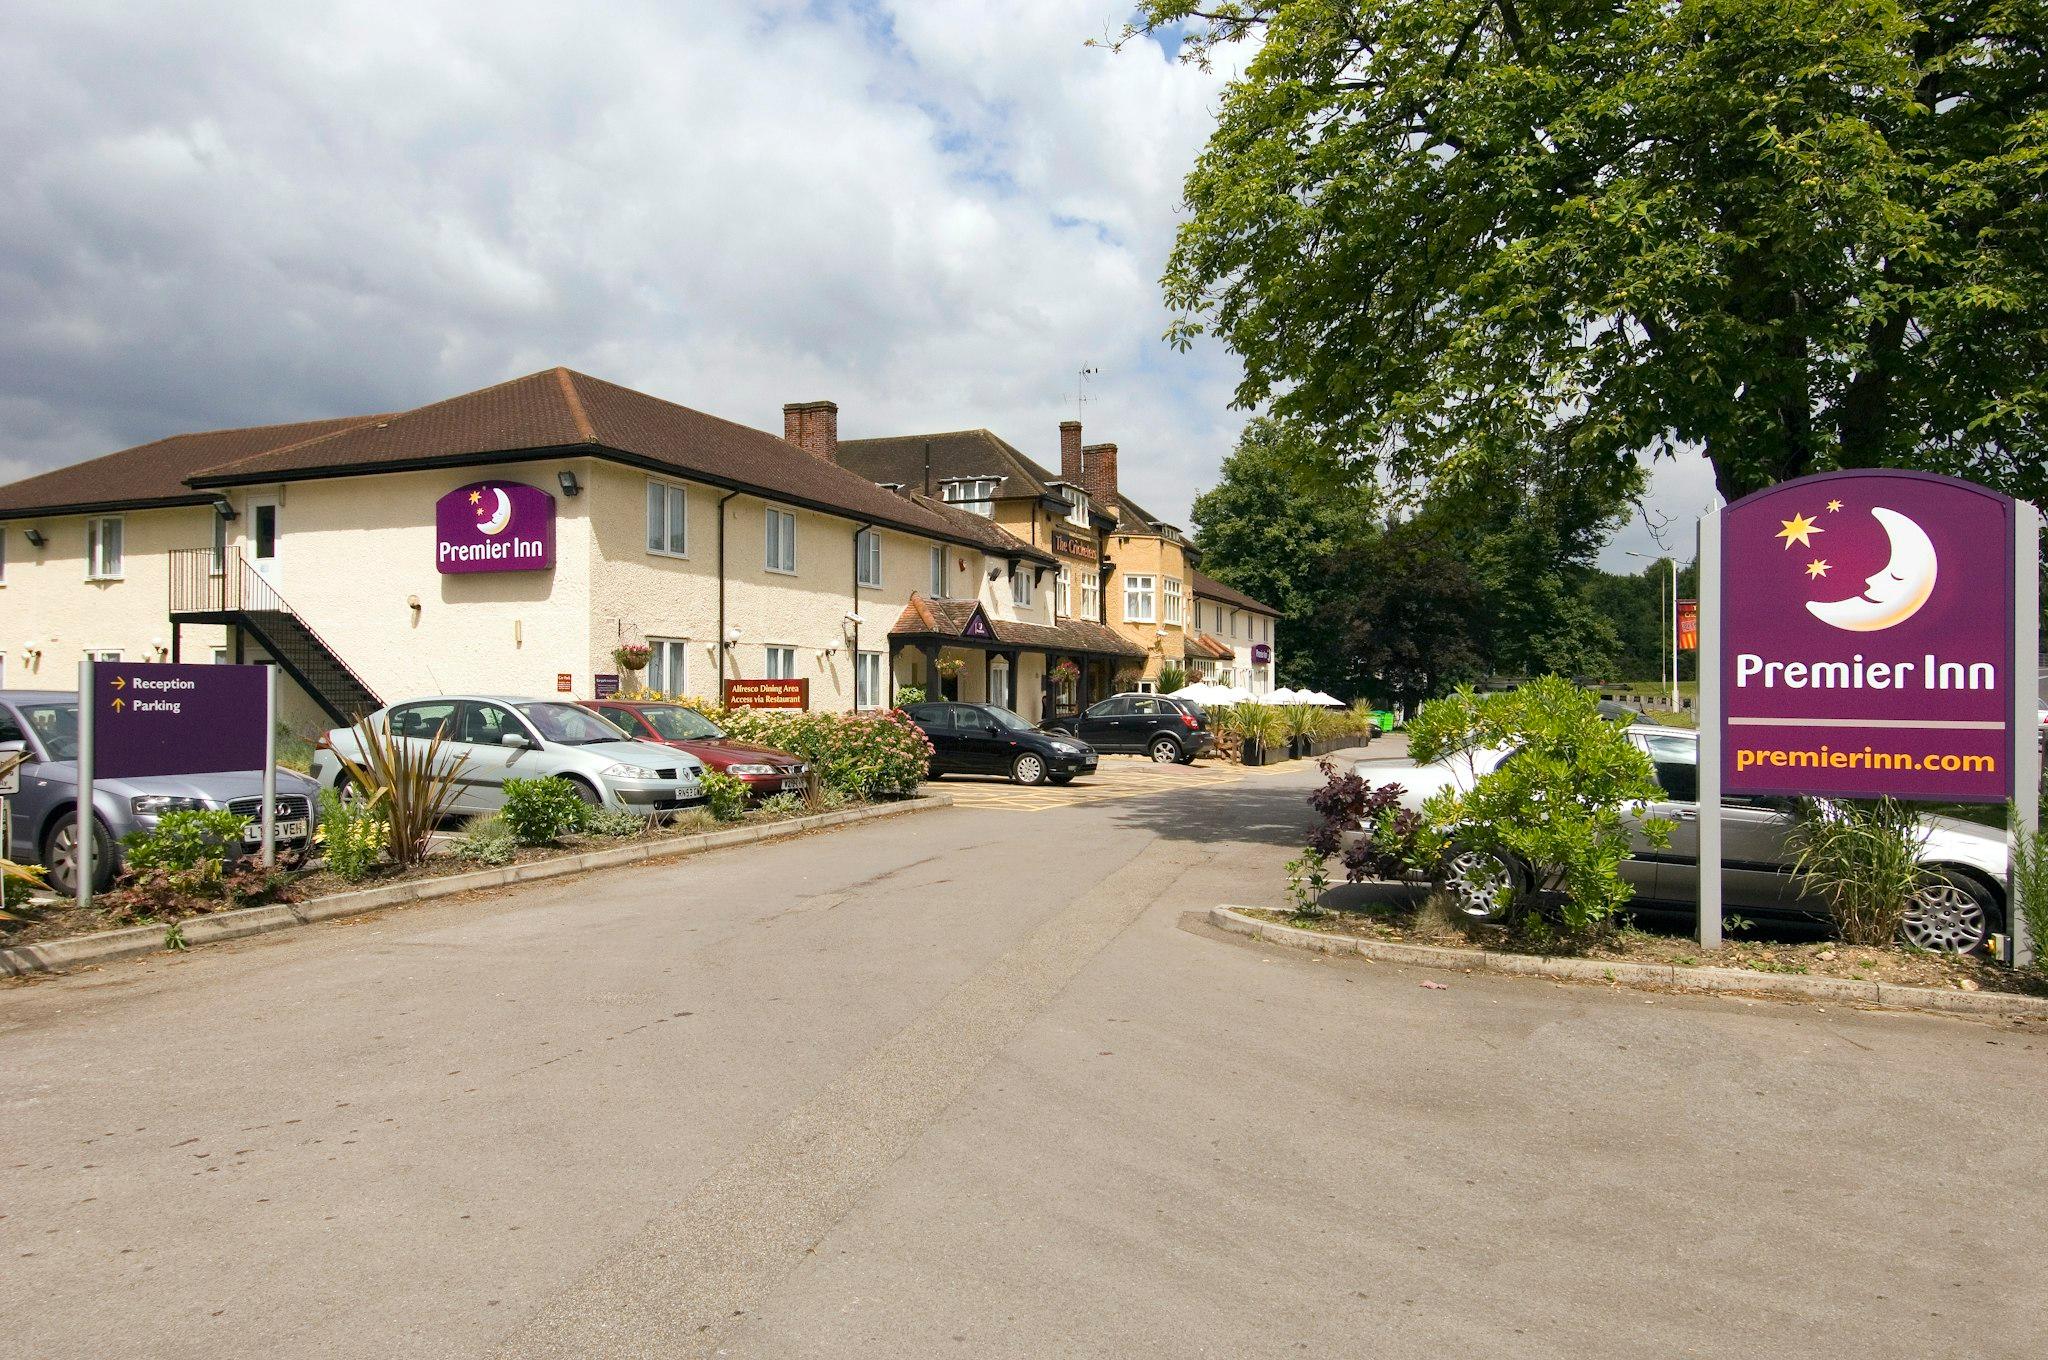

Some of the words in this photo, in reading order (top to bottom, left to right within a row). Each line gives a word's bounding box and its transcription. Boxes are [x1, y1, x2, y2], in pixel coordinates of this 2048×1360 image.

[439, 539, 511, 563] Premier
[514, 536, 543, 558] Inn
[1056, 535, 1068, 552] The
[1736, 653, 1915, 690] Premier
[1924, 654, 1996, 690] Inn
[132, 677, 195, 692] Reception
[732, 684, 759, 693] Alfresco
[760, 684, 783, 694] Dining
[783, 684, 800, 693] Area
[132, 700, 182, 713] Parking
[731, 695, 753, 703] Access
[753, 695, 765, 703] via
[765, 695, 801, 703] Restaurant
[1736, 745, 1996, 772] premierinn.com
